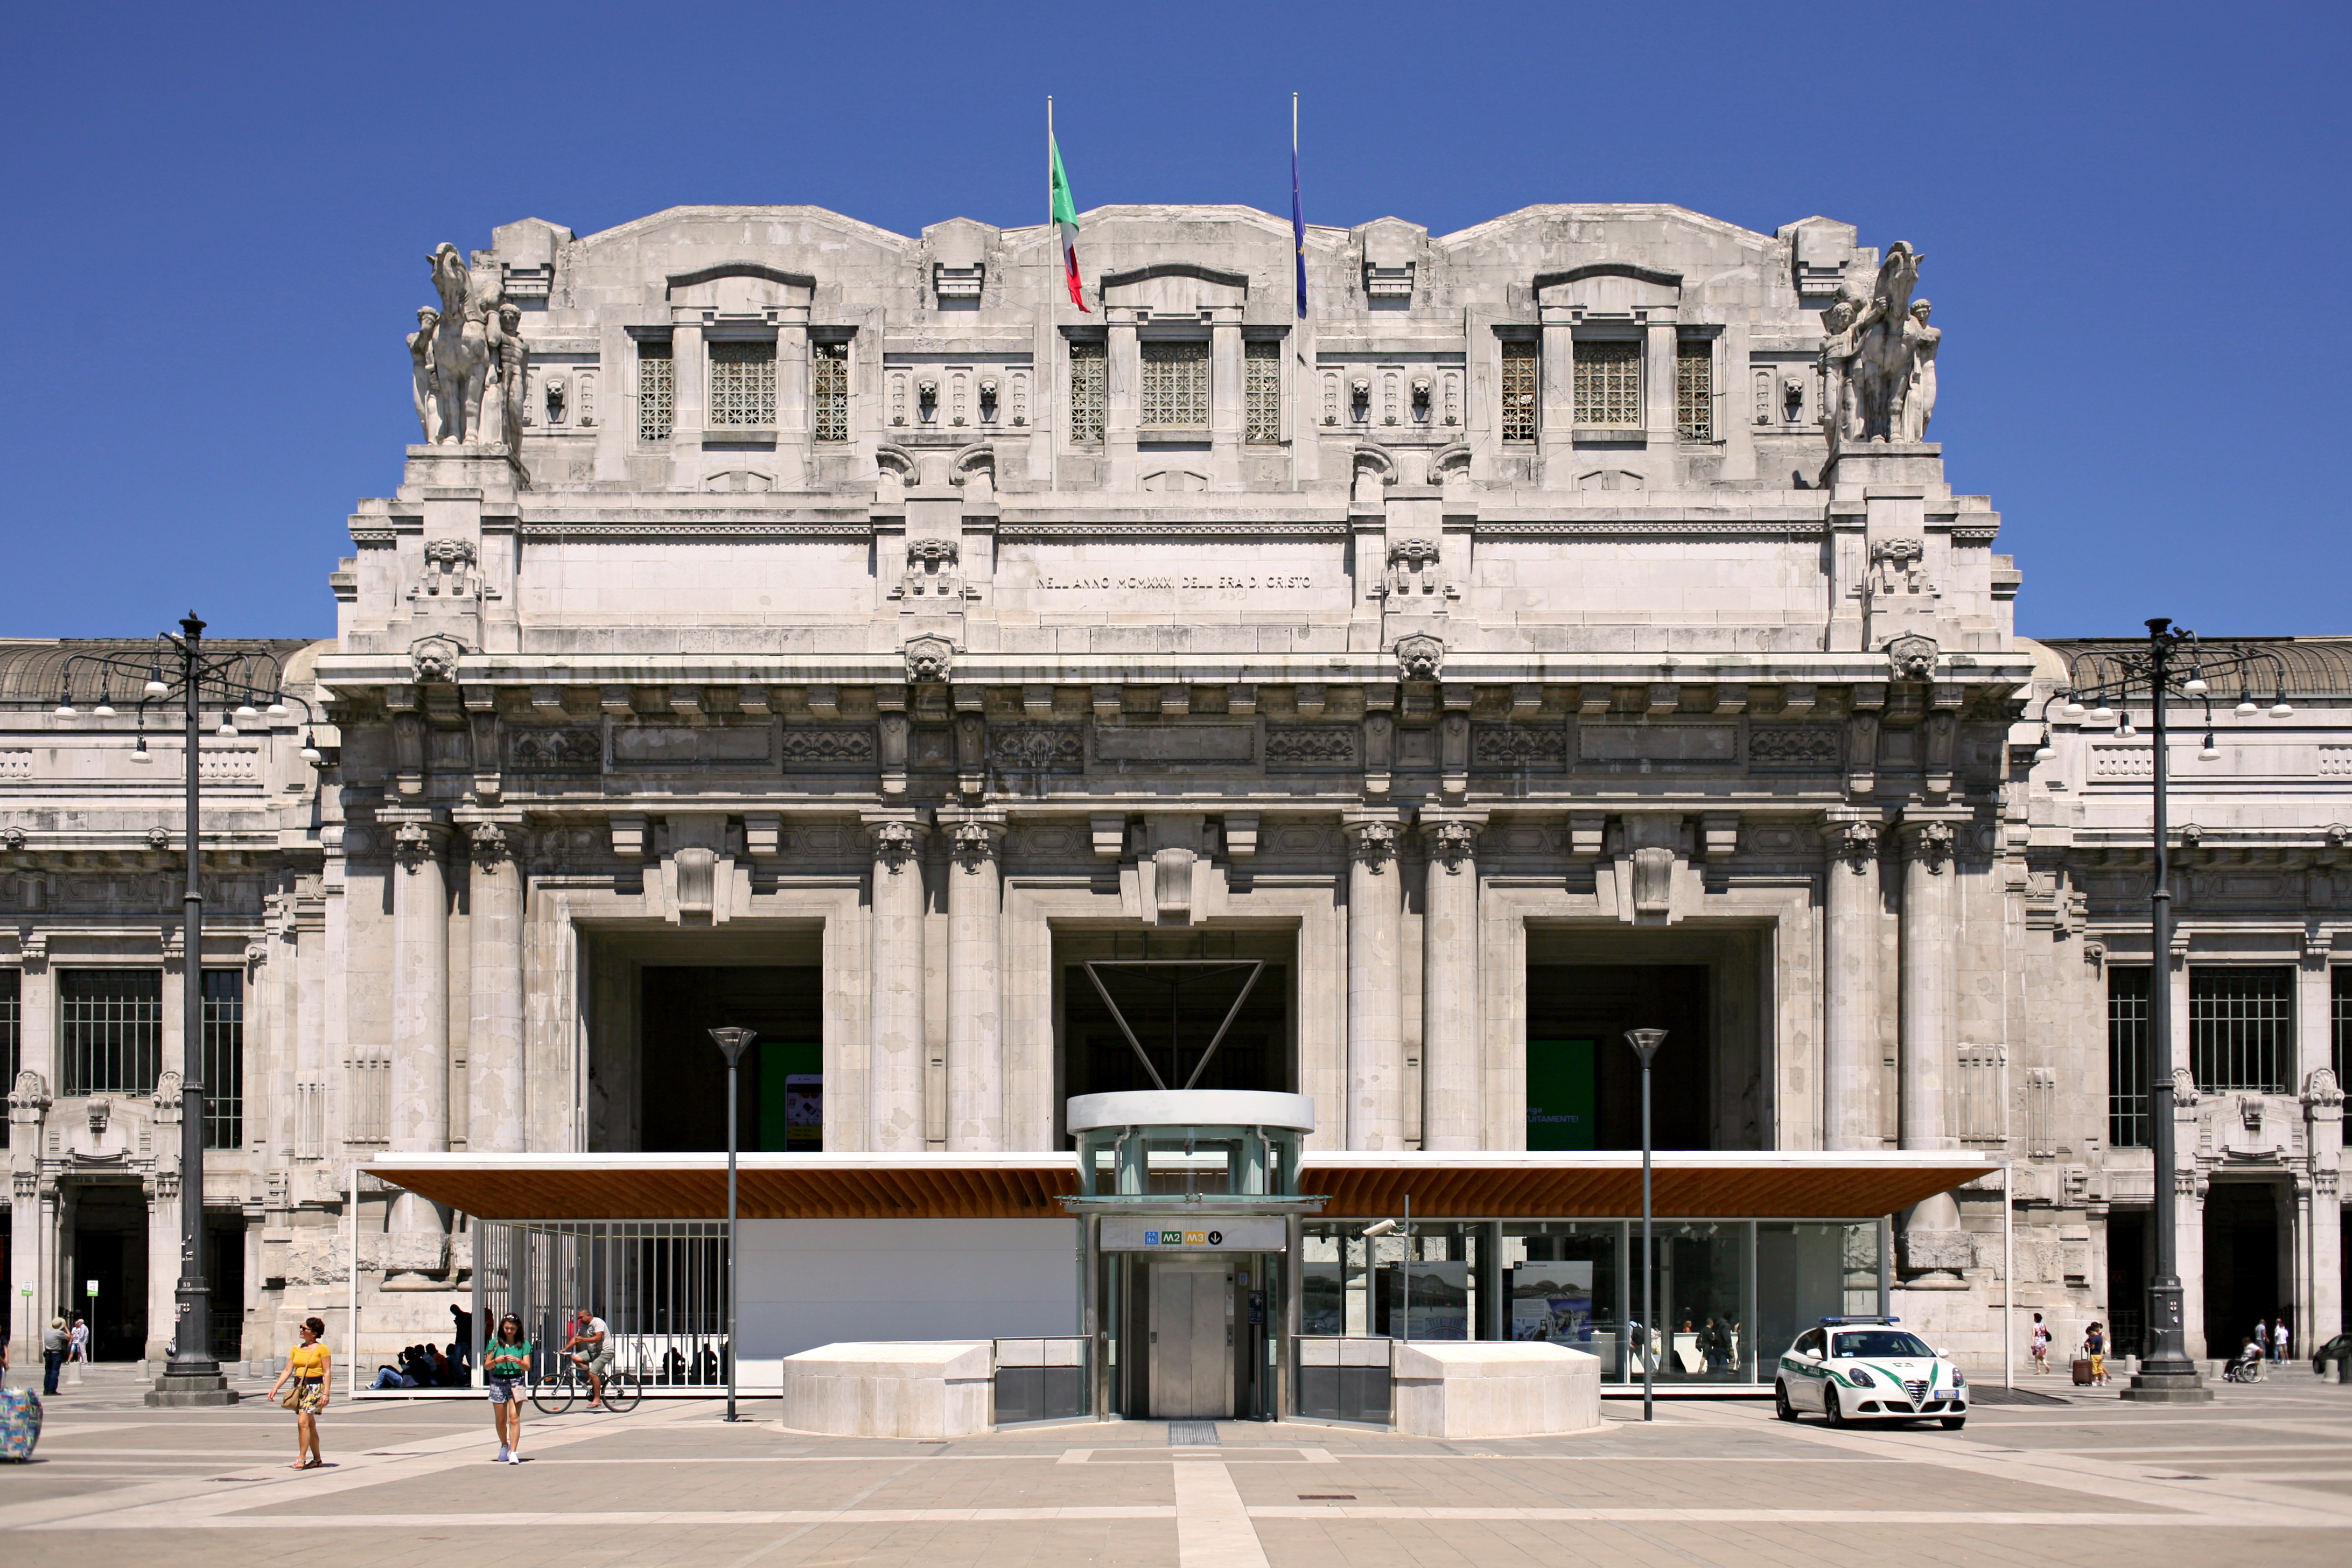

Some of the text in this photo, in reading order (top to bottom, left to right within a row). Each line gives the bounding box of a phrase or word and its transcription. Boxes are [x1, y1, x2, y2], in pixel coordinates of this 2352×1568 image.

[1073, 577, 1110, 589] ANNO
[1219, 577, 1244, 589] ERA
[1266, 577, 1311, 589] CRISTO
[1163, 1234, 1203, 1242] M2 M3
[1808, 1367, 1820, 1375] LOCALE
